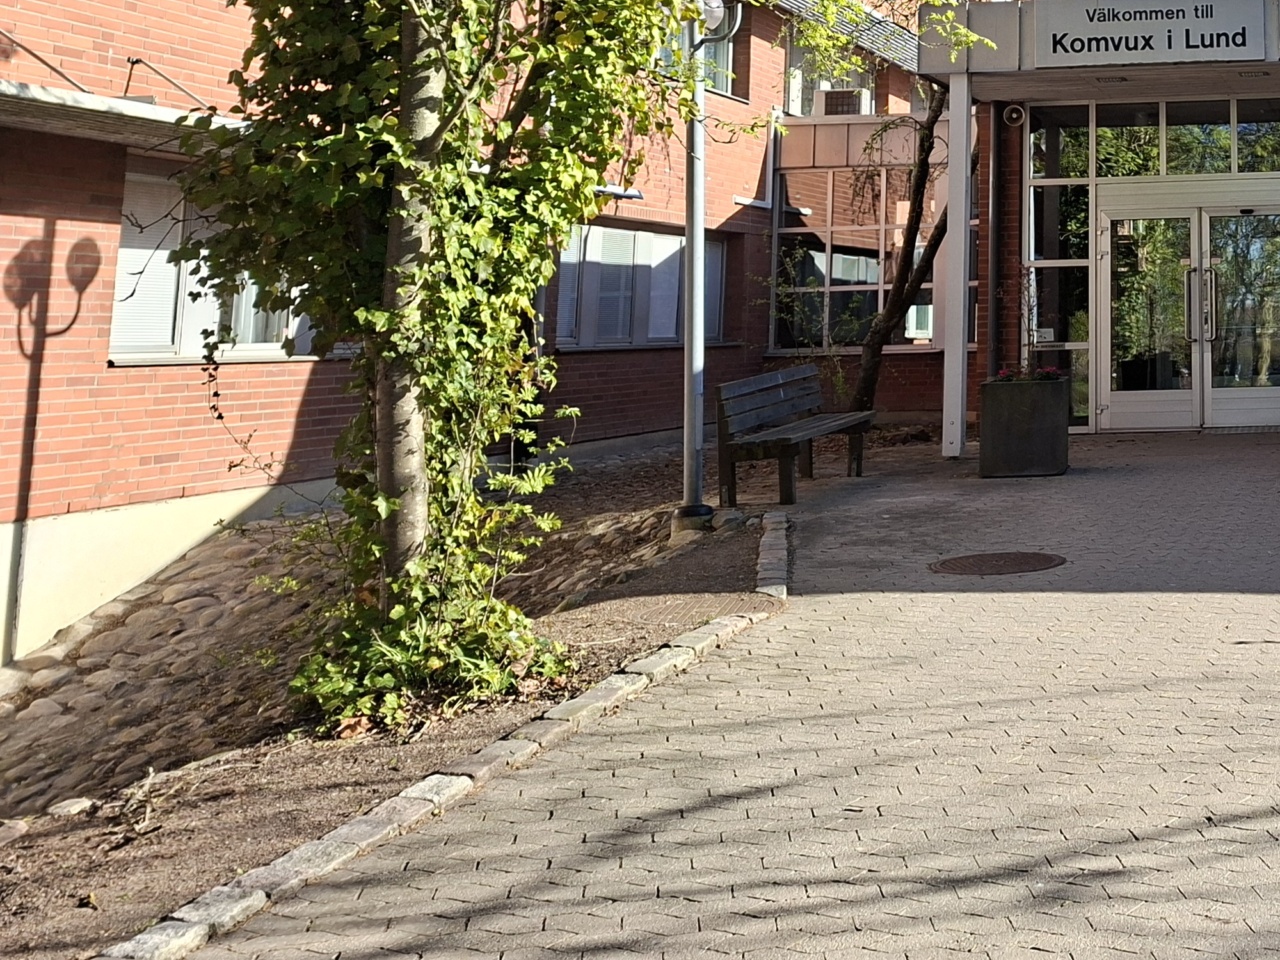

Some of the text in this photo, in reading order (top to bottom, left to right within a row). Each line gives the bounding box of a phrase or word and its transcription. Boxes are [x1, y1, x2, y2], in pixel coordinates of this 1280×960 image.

[1085, 4, 1214, 23] Välkommen till
[1051, 26, 1247, 54] Komvux i Lund
